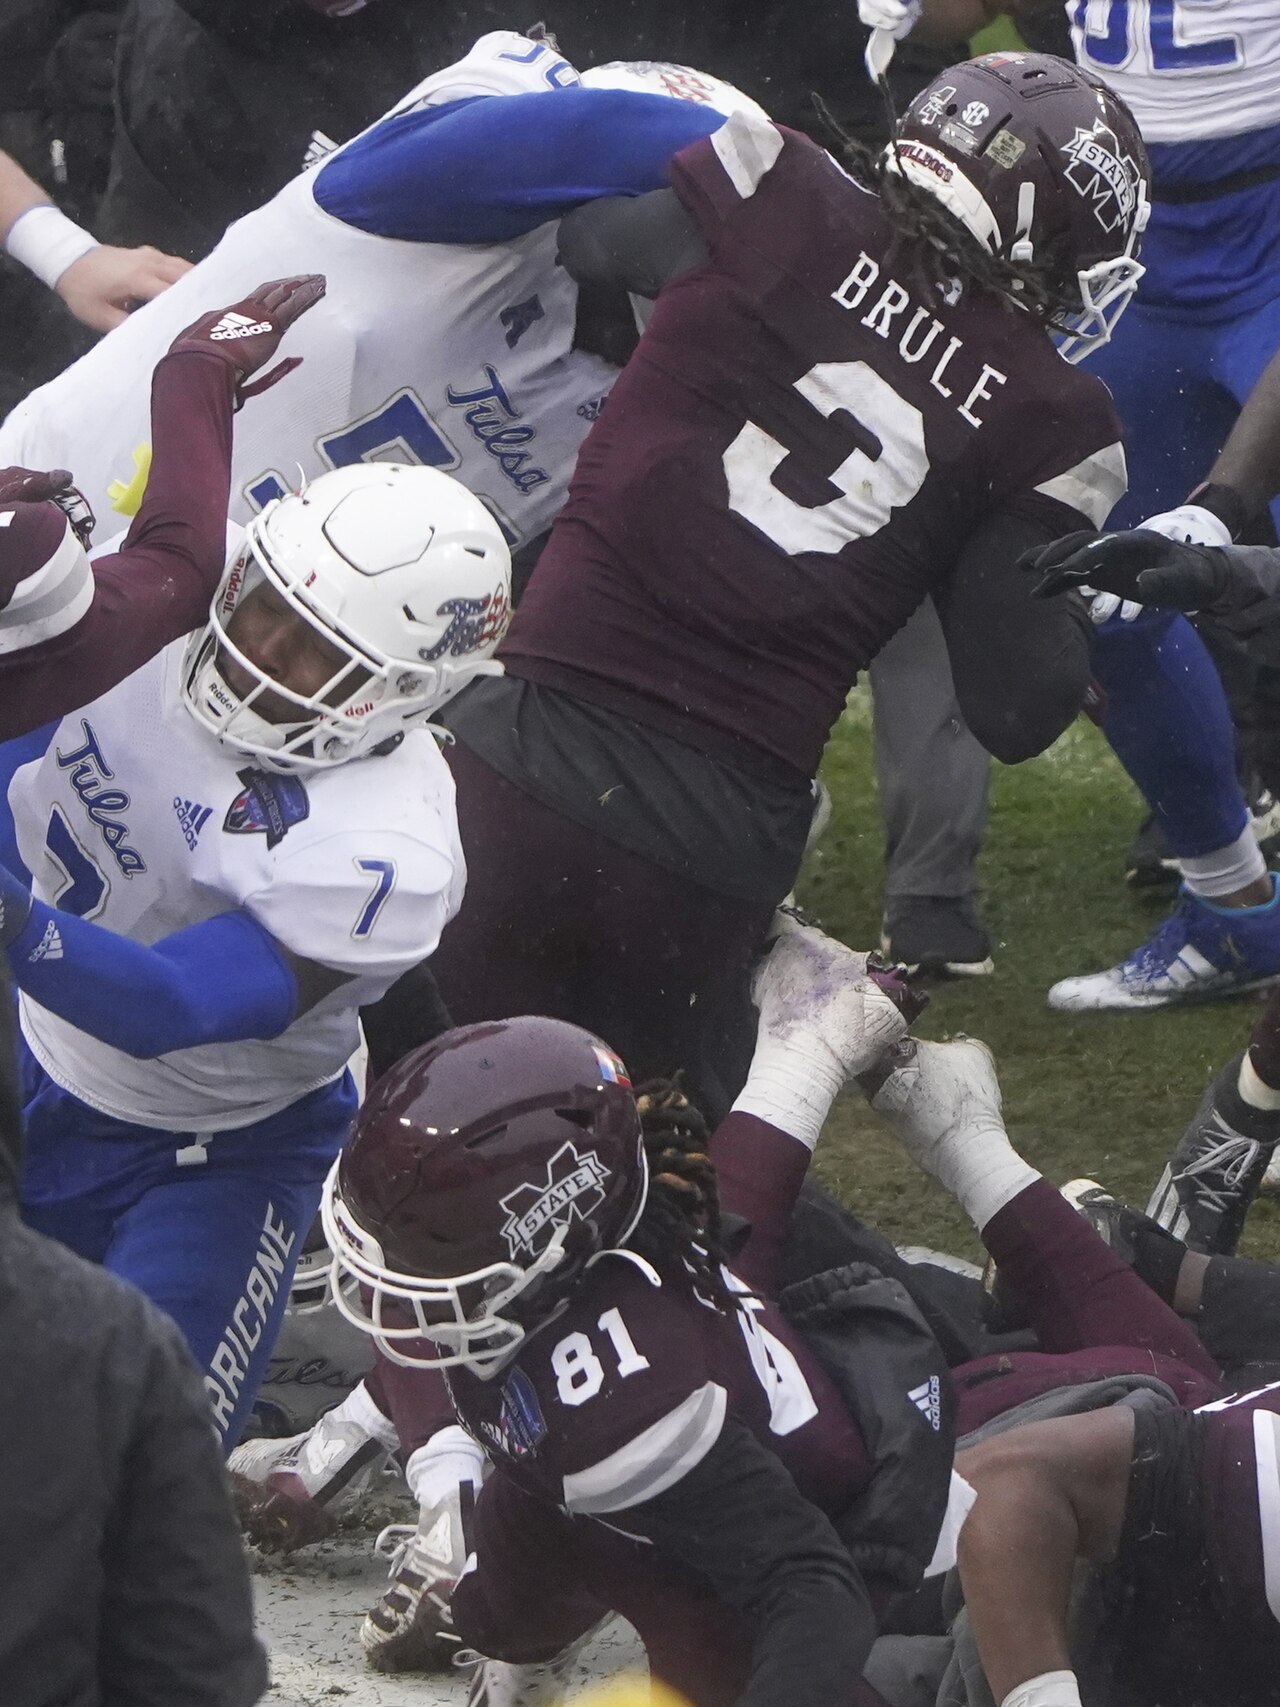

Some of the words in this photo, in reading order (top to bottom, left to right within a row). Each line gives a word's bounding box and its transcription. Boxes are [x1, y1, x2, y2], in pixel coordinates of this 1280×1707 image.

[1084, 144, 1131, 208] STATE
[209, 321, 273, 341] adidas
[830, 250, 1007, 429] BRULE
[444, 363, 551, 495] Tulsa
[721, 359, 931, 556] 3
[207, 681, 239, 714] Riddel
[56, 717, 148, 880] Tulsa
[173, 796, 199, 852] adidas
[351, 856, 396, 940] 7
[523, 1172, 590, 1233] STATE
[204, 1201, 296, 1444] RRICANE
[551, 1307, 650, 1406] 81
[929, 1374, 940, 1431] adidas
